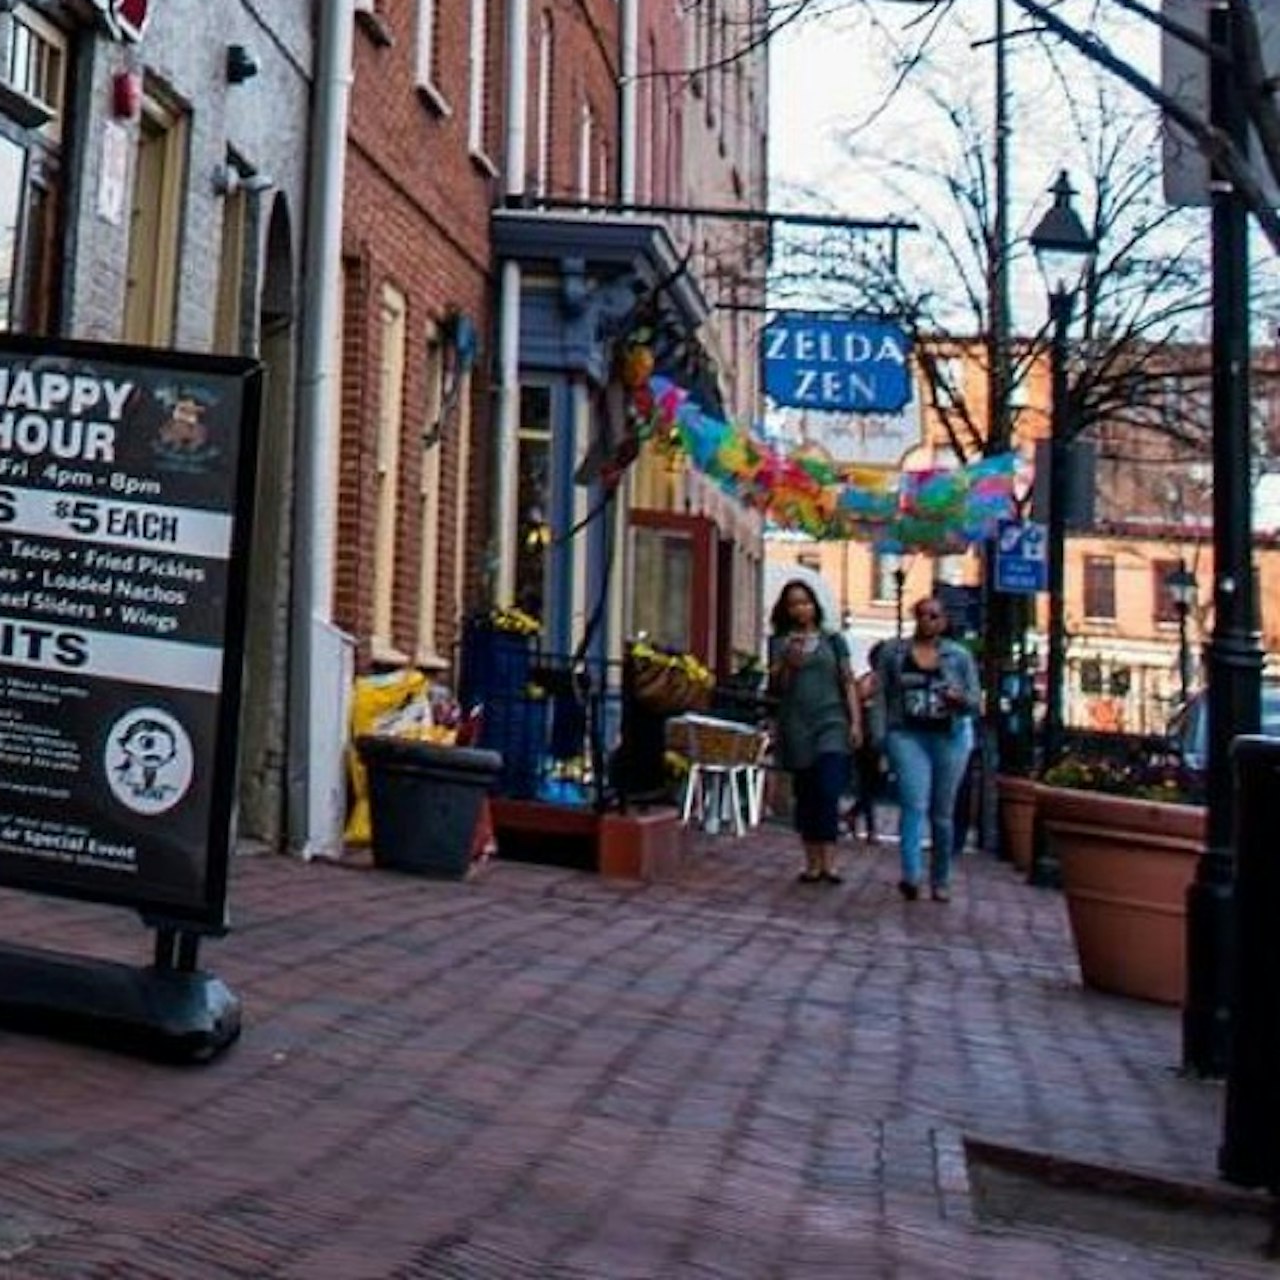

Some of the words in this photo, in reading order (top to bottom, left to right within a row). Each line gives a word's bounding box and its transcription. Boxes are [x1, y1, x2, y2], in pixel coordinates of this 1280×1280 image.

[764, 328, 905, 366] ZELDA
[793, 369, 878, 403] ZEN
[54, 499, 99, 534] $5
[106, 507, 178, 543] EACH
[11, 539, 61, 561] Tacos
[84, 548, 134, 572] Fried
[138, 556, 205, 583] Pickles
[42, 567, 113, 594] Loaded
[116, 580, 186, 605] Nachos
[32, 591, 96, 619] Sliders
[120, 604, 179, 633] Wings
[22, 828, 84, 853] Special
[88, 838, 137, 859] Event
